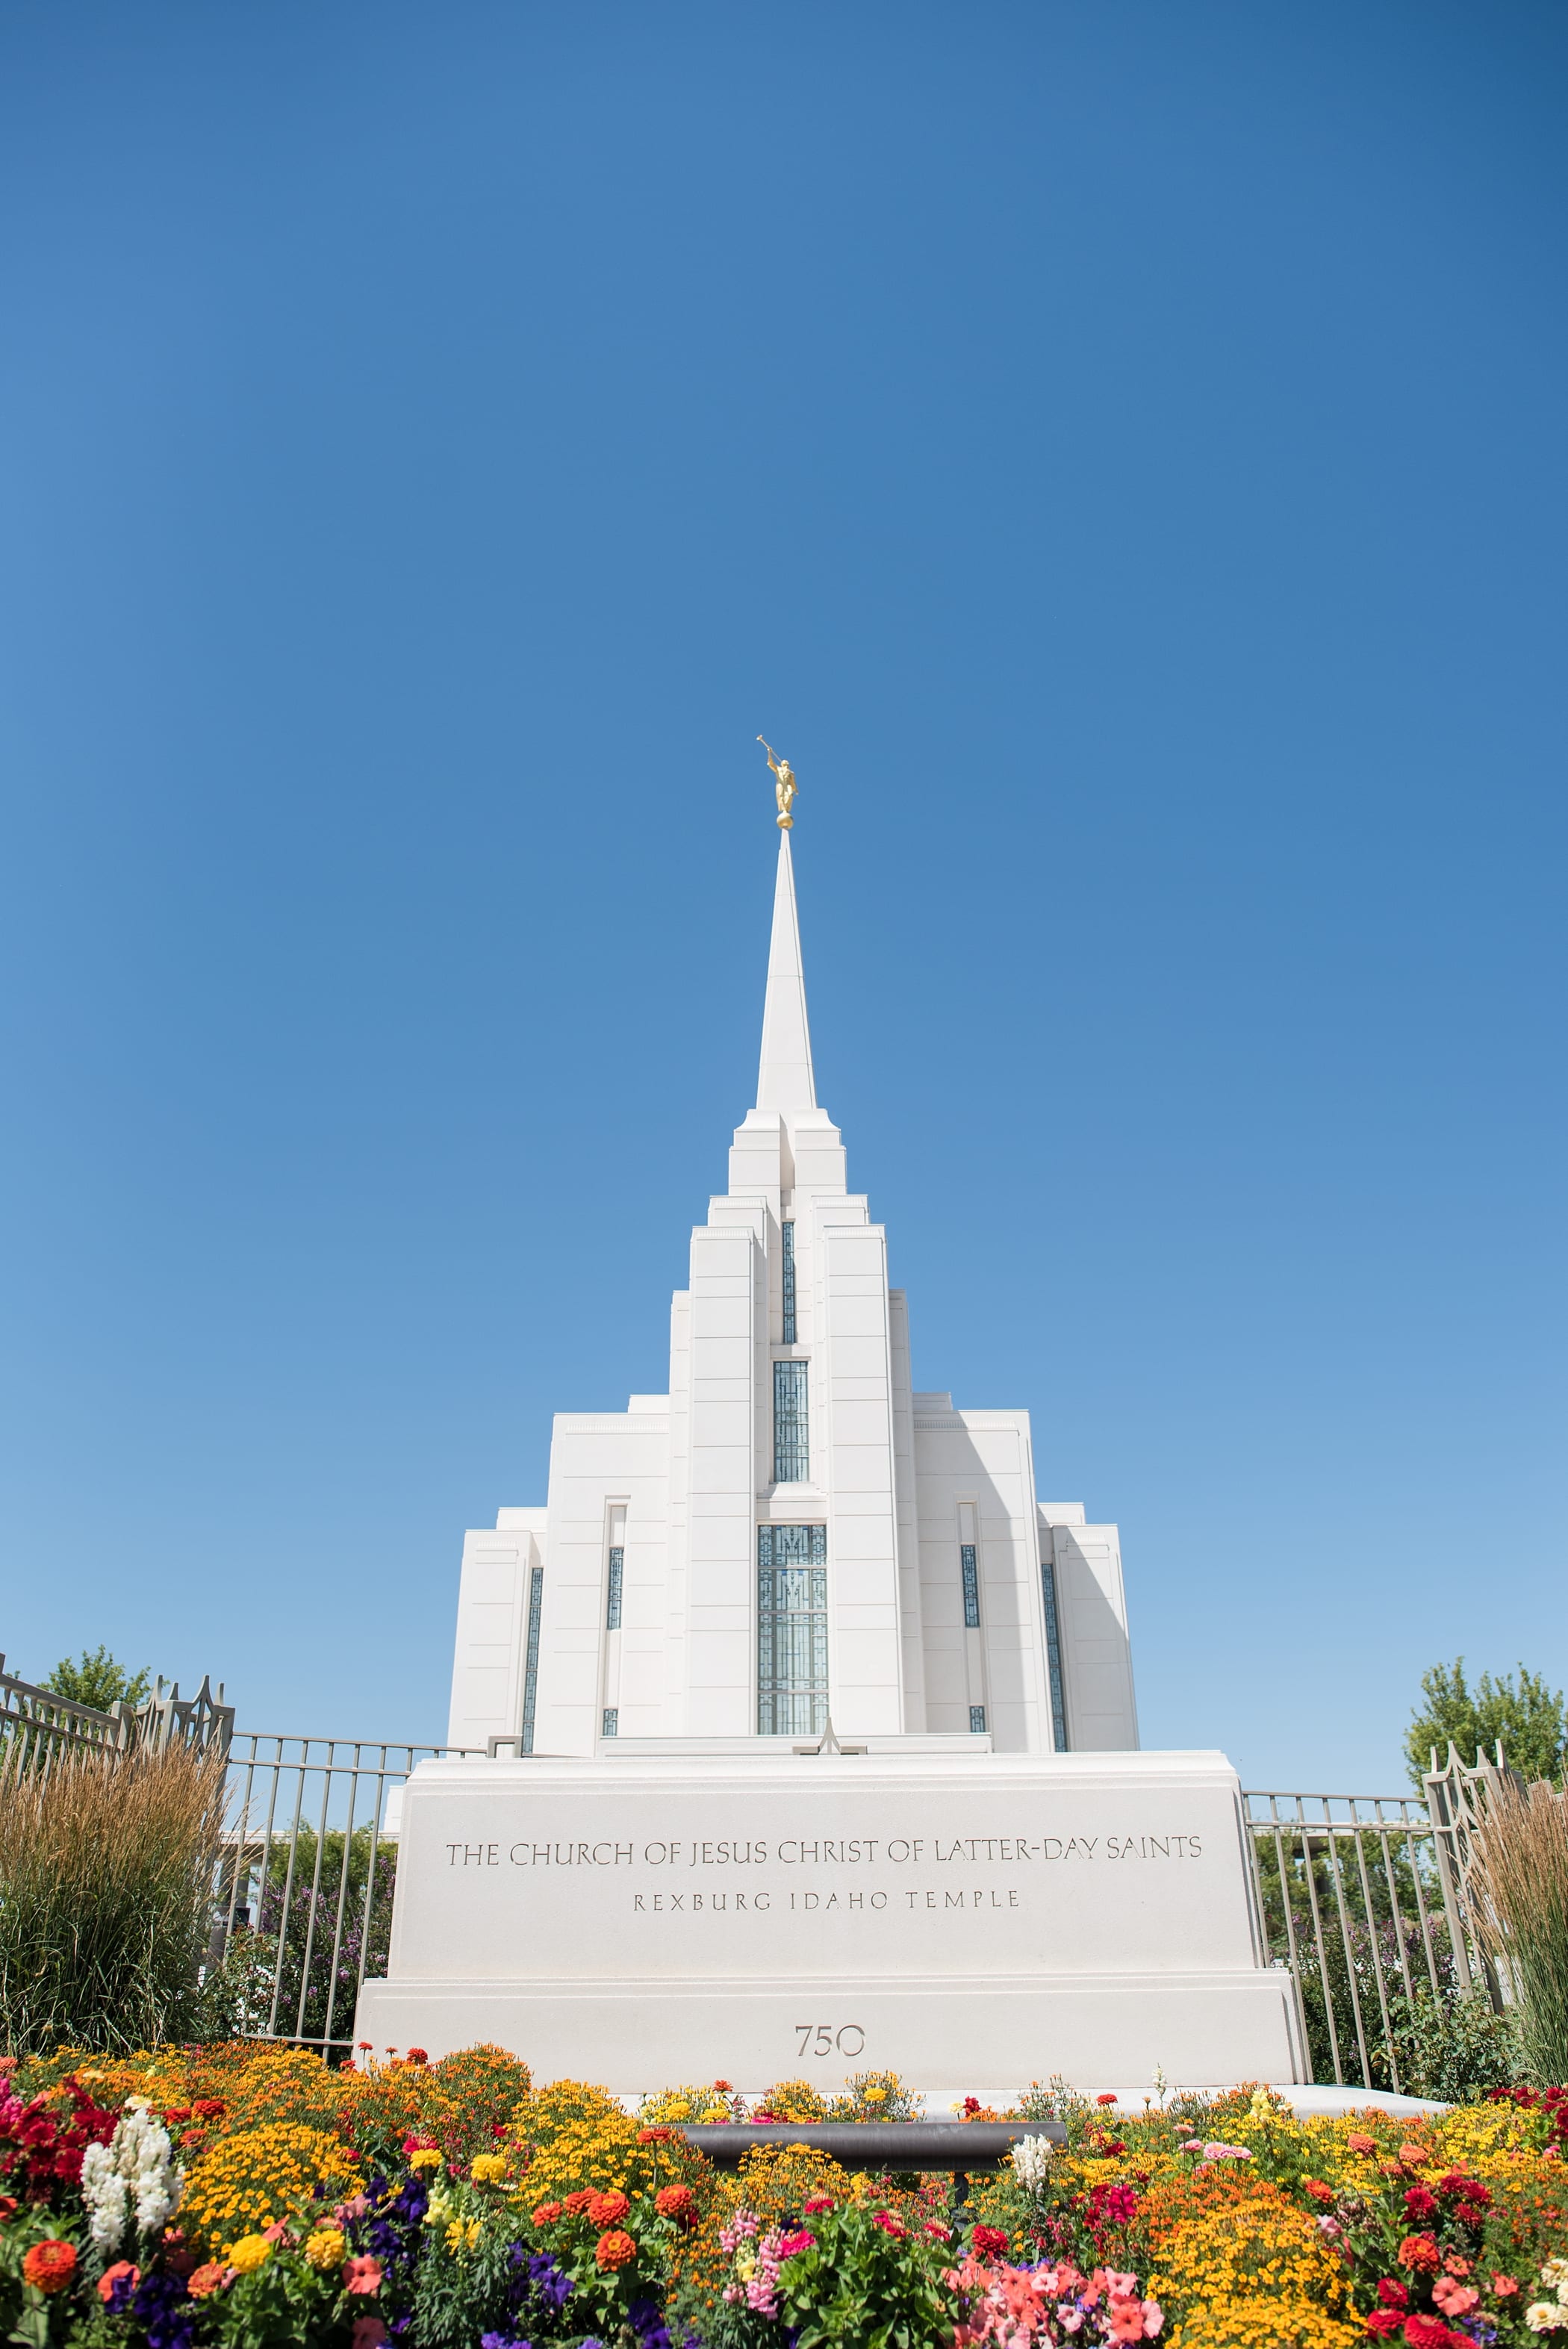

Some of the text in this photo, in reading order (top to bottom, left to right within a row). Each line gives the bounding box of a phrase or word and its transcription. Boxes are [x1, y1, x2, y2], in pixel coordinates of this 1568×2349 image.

[446, 1835, 1202, 1867] THE CHURCH OF JESUS CHRIST OF LATTER-DAY SAINTS
[633, 1890, 1019, 1911] REXBURG IDAHO TEMPLE
[794, 2024, 865, 2057] 750
